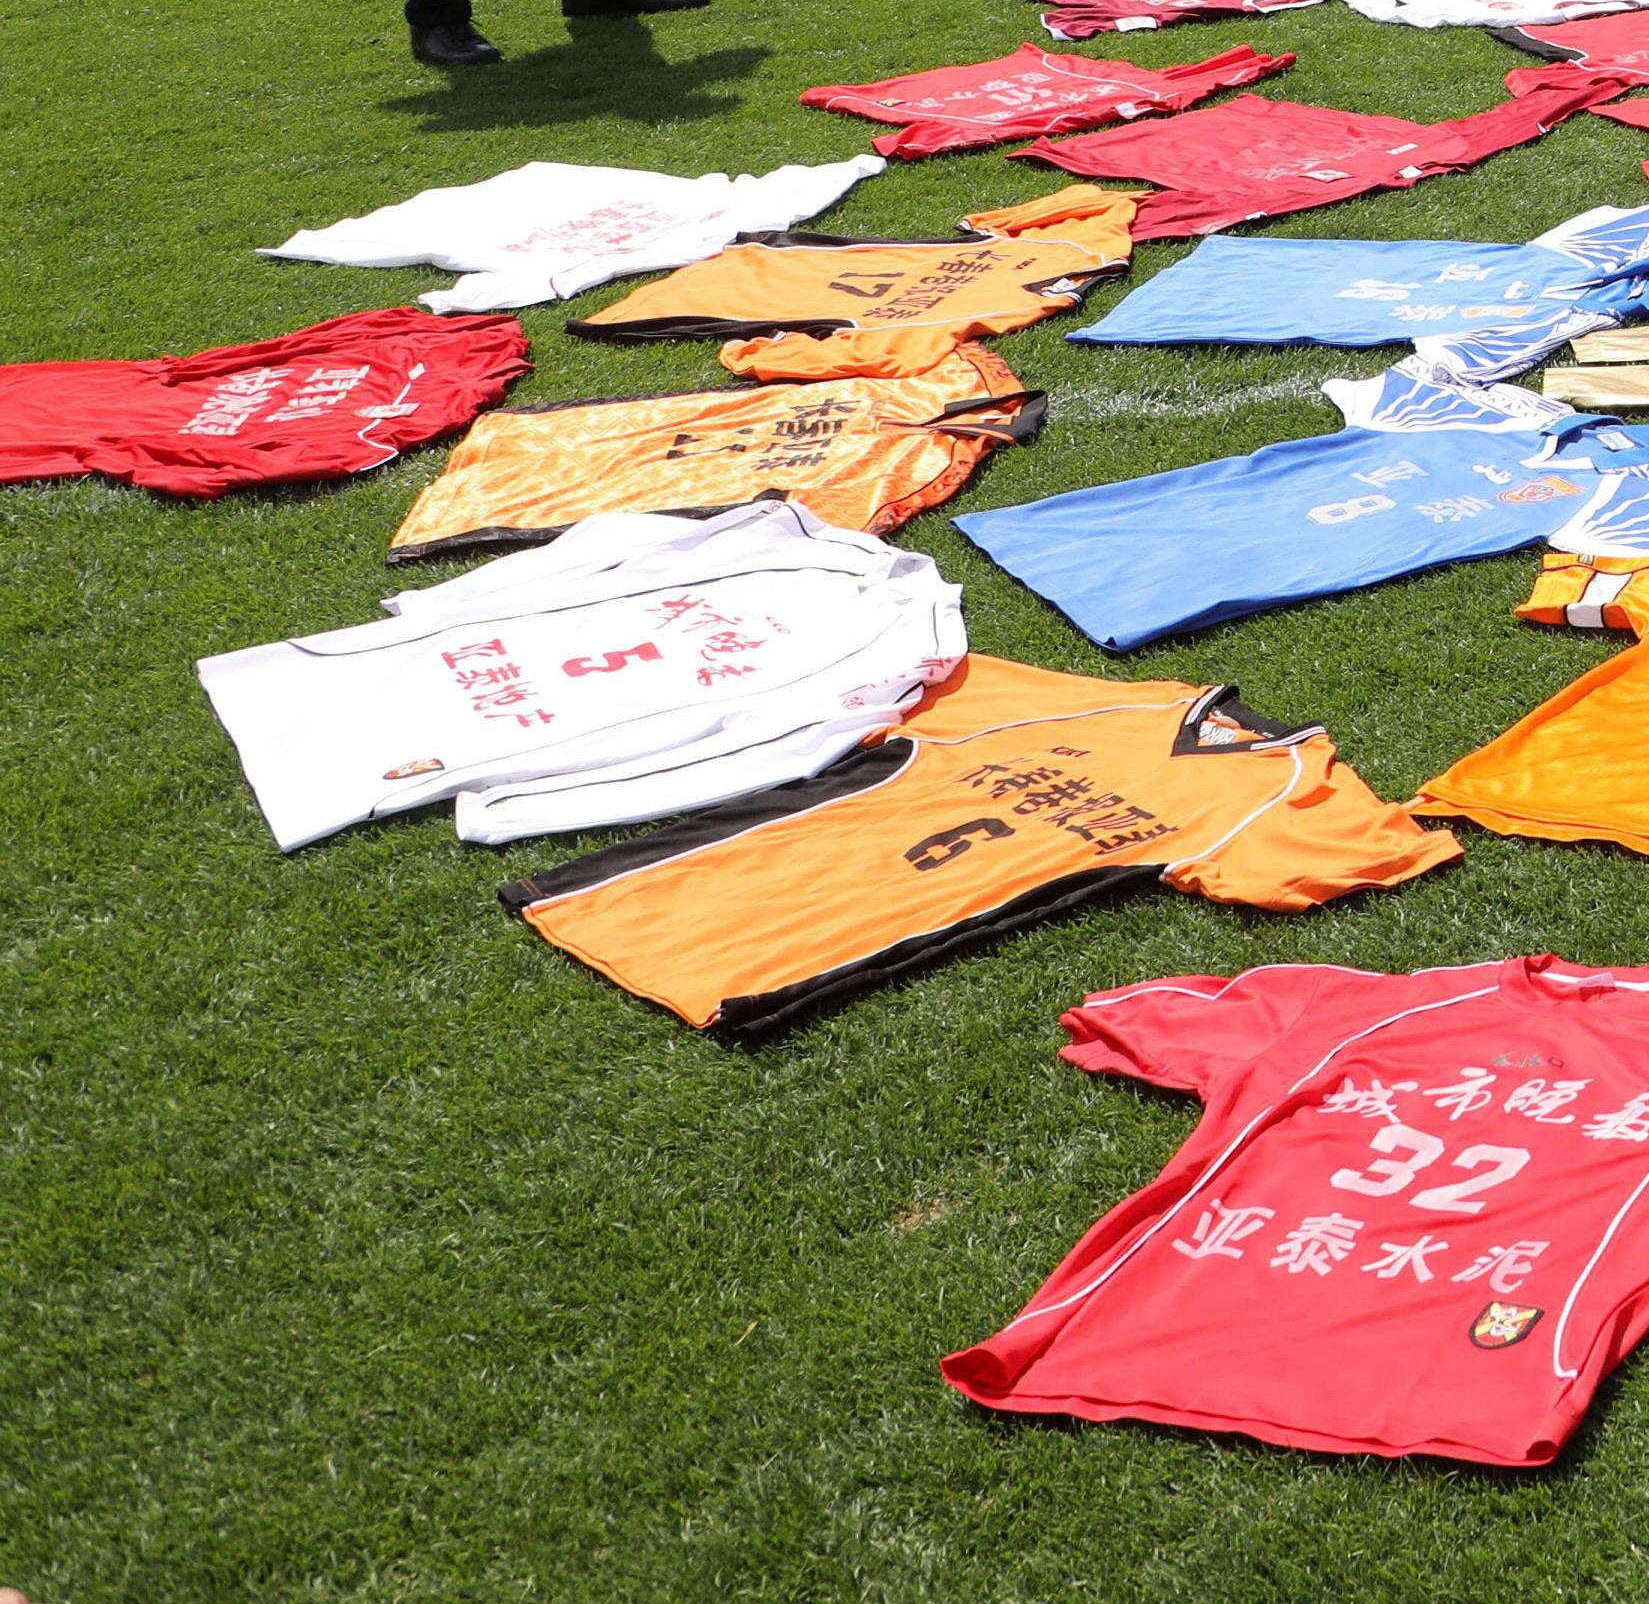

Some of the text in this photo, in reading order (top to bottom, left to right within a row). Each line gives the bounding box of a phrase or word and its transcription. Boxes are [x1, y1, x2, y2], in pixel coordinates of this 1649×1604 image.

[1303, 493, 1398, 526] 8
[439, 636, 555, 732] 亚泰地产
[561, 640, 667, 682] 5
[901, 815, 1016, 875] 6
[951, 757, 1182, 858] 长春巷报亚泰
[1330, 1125, 1534, 1216] 32
[1171, 1197, 1552, 1295] 亚泰水泥
